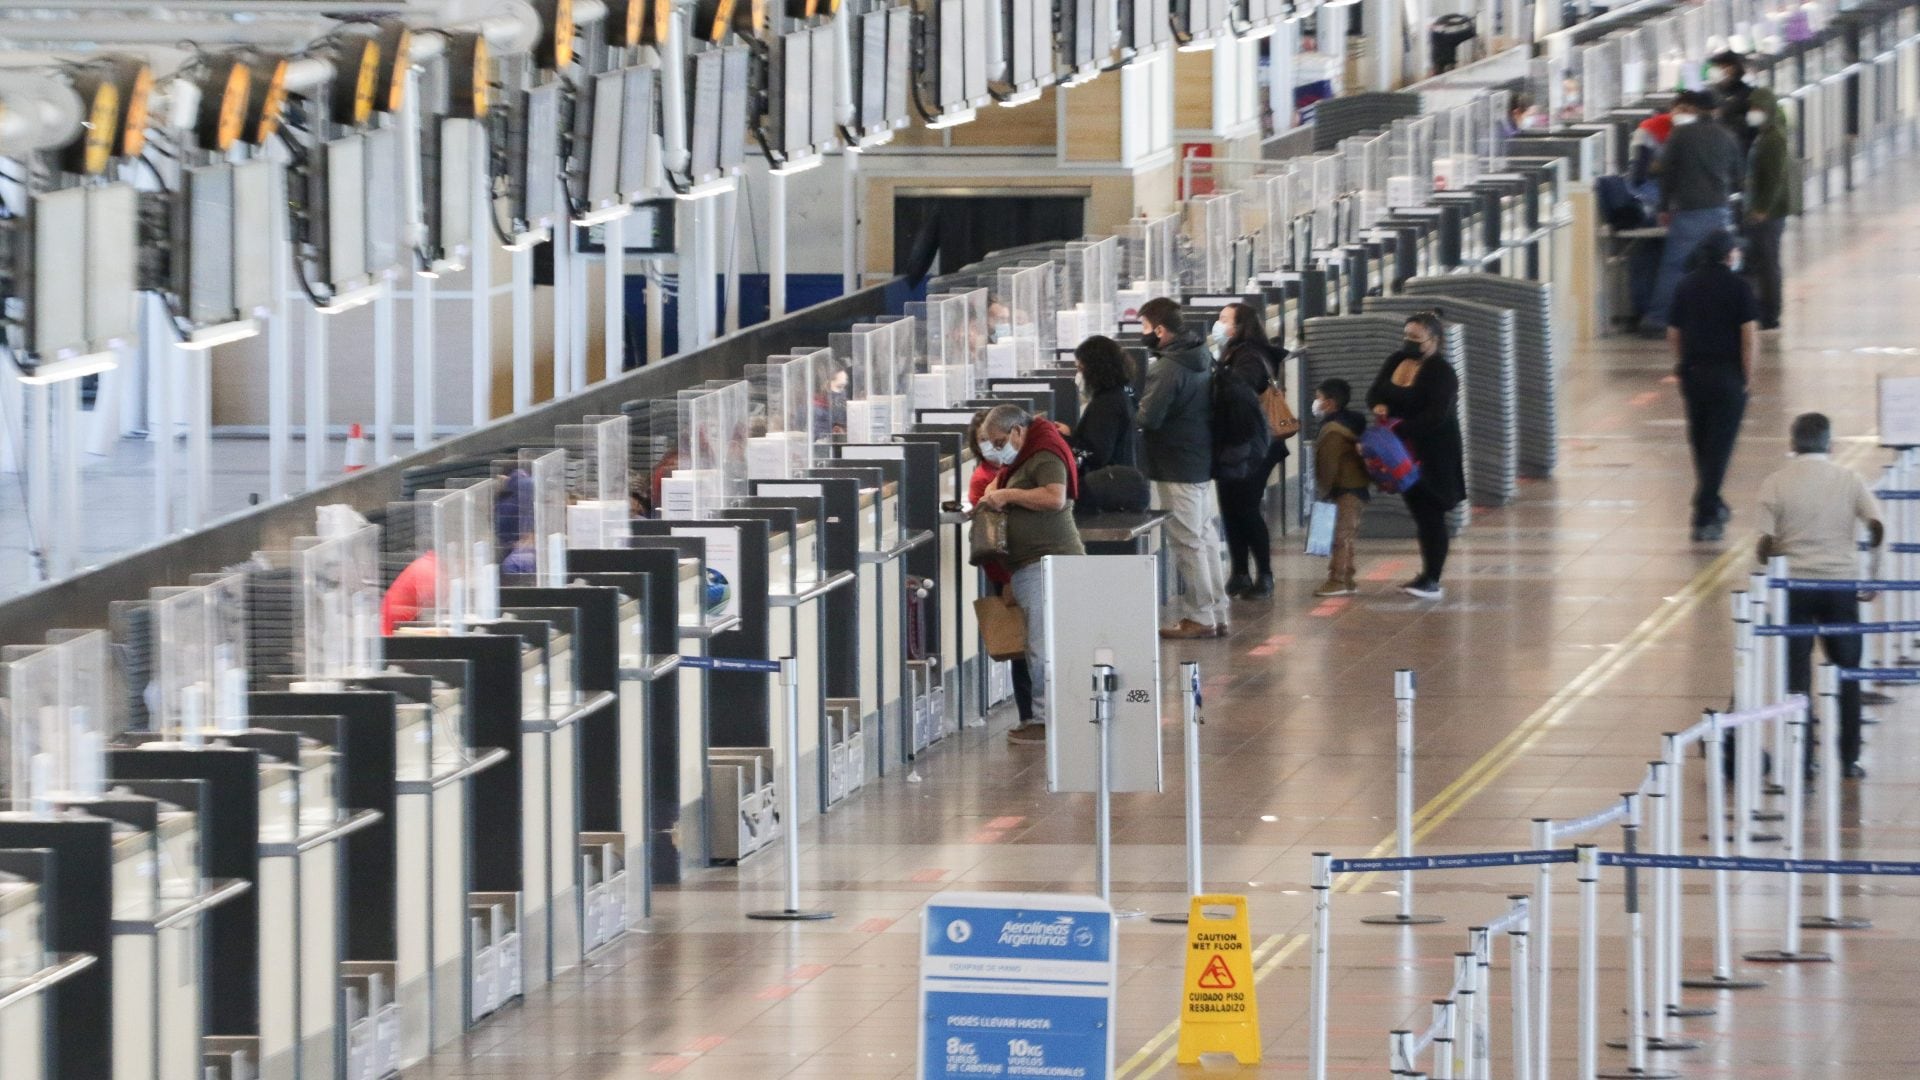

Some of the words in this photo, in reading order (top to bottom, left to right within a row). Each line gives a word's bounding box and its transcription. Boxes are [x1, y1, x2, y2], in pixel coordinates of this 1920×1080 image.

[998, 932, 1068, 947] Argentinas
[1197, 933, 1237, 941] CAUTION
[1192, 942, 1210, 950] WET
[1214, 942, 1242, 950] FLOOR
[1189, 993, 1223, 1001] CUIDADO
[1226, 993, 1244, 1001] PISO
[1189, 1003, 1245, 1012] RESBALADIZO
[981, 1017, 1016, 1028] LLEVAR
[1018, 1018, 1051, 1029] HASTA
[946, 1056, 978, 1064] VUELOS
[1008, 1057, 1043, 1066] VUELOS
[946, 1064, 957, 1072] DE
[960, 1064, 1002, 1074] CABOTAJE
[1008, 1067, 1085, 1077] INTERNACIONALES
